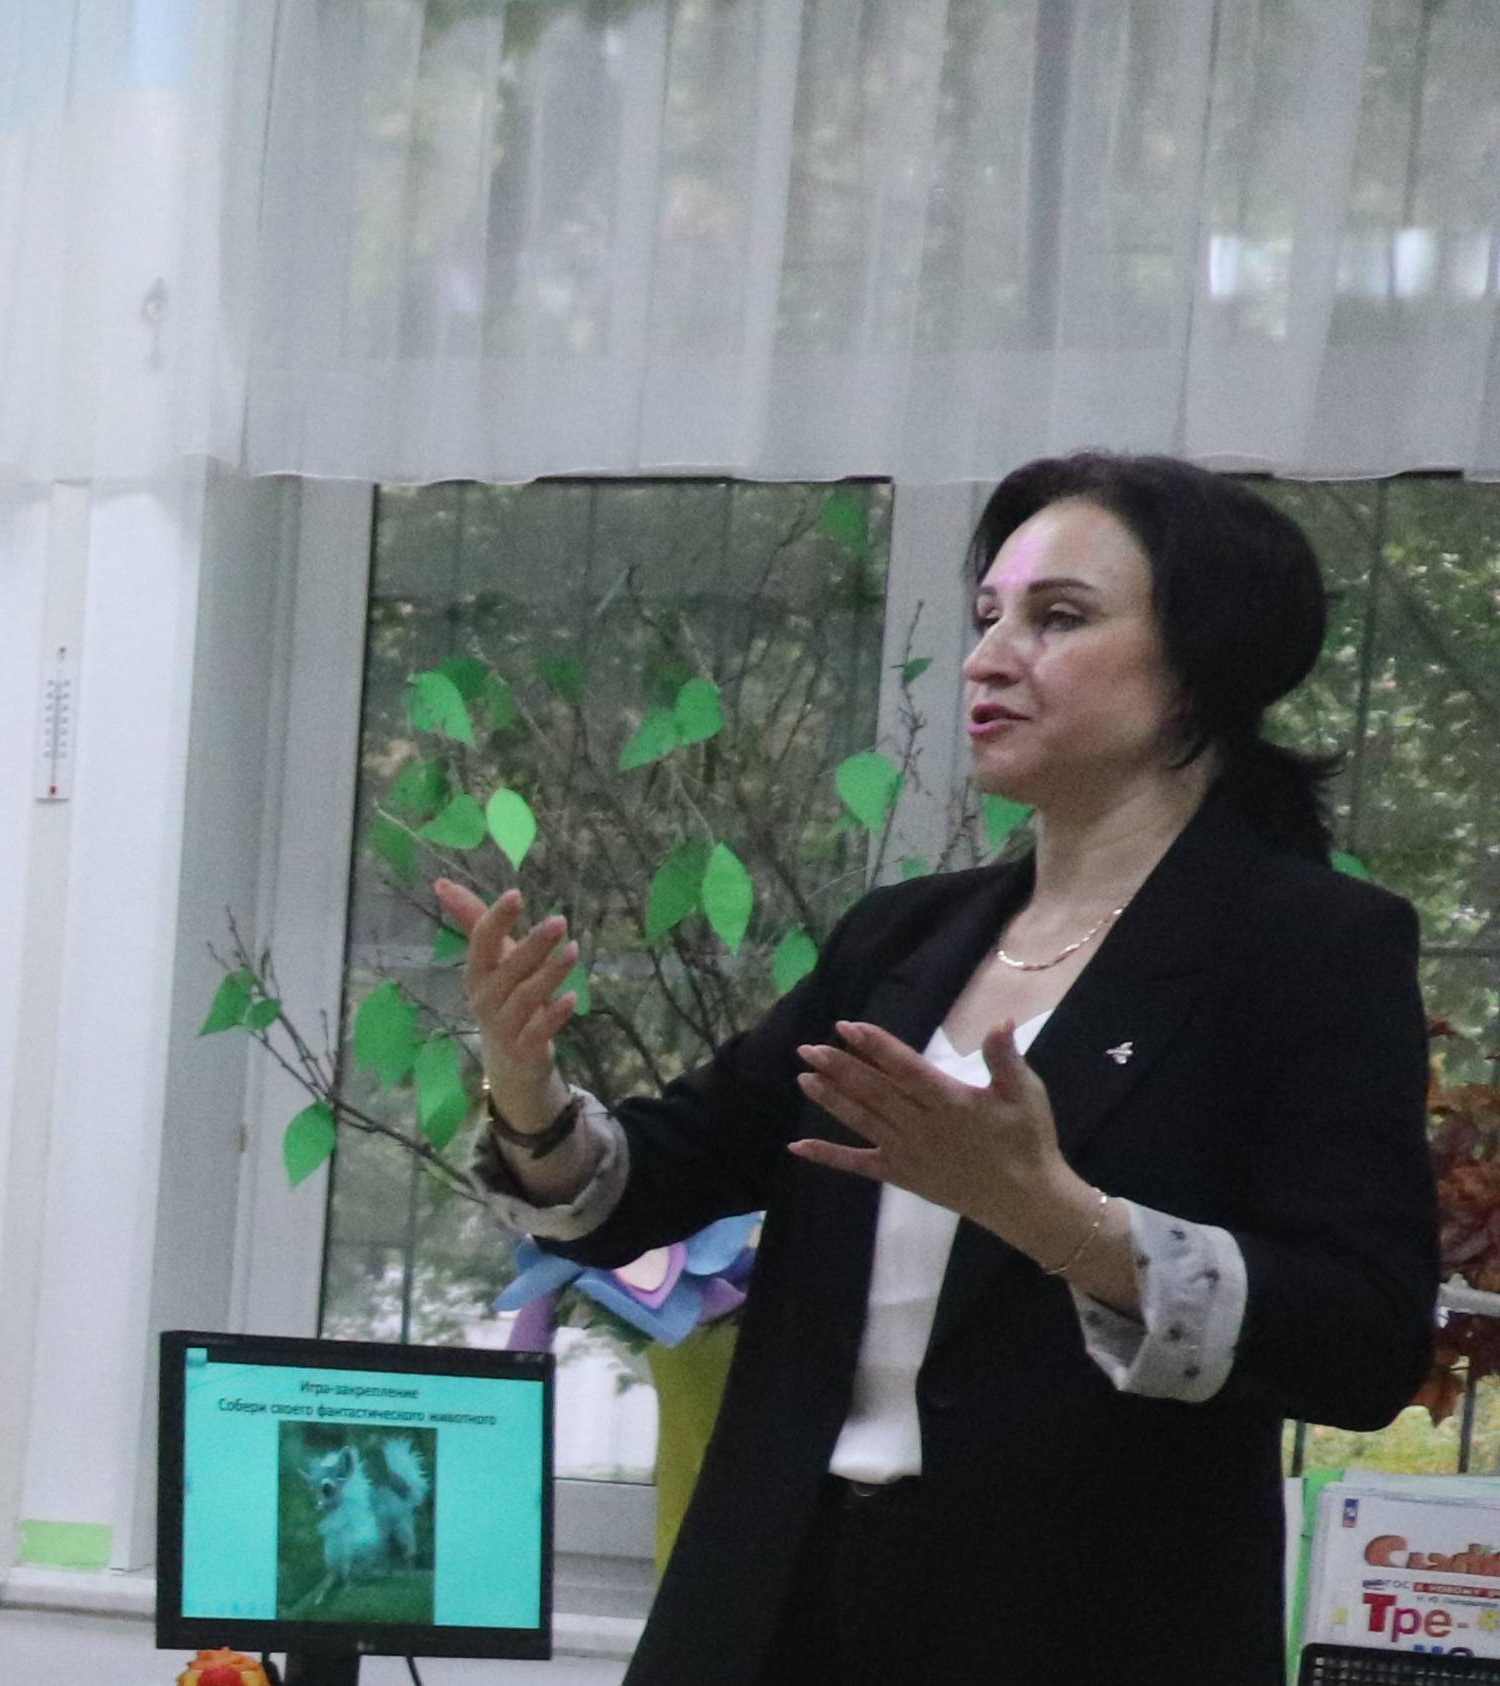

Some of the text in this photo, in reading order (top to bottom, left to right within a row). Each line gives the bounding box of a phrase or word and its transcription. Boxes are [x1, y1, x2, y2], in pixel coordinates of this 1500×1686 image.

[300, 1380, 419, 1399] Игра-закрепление
[219, 1398, 497, 1426] Собери своего фантастического животного
[1362, 1592, 1469, 1643] Тре-
